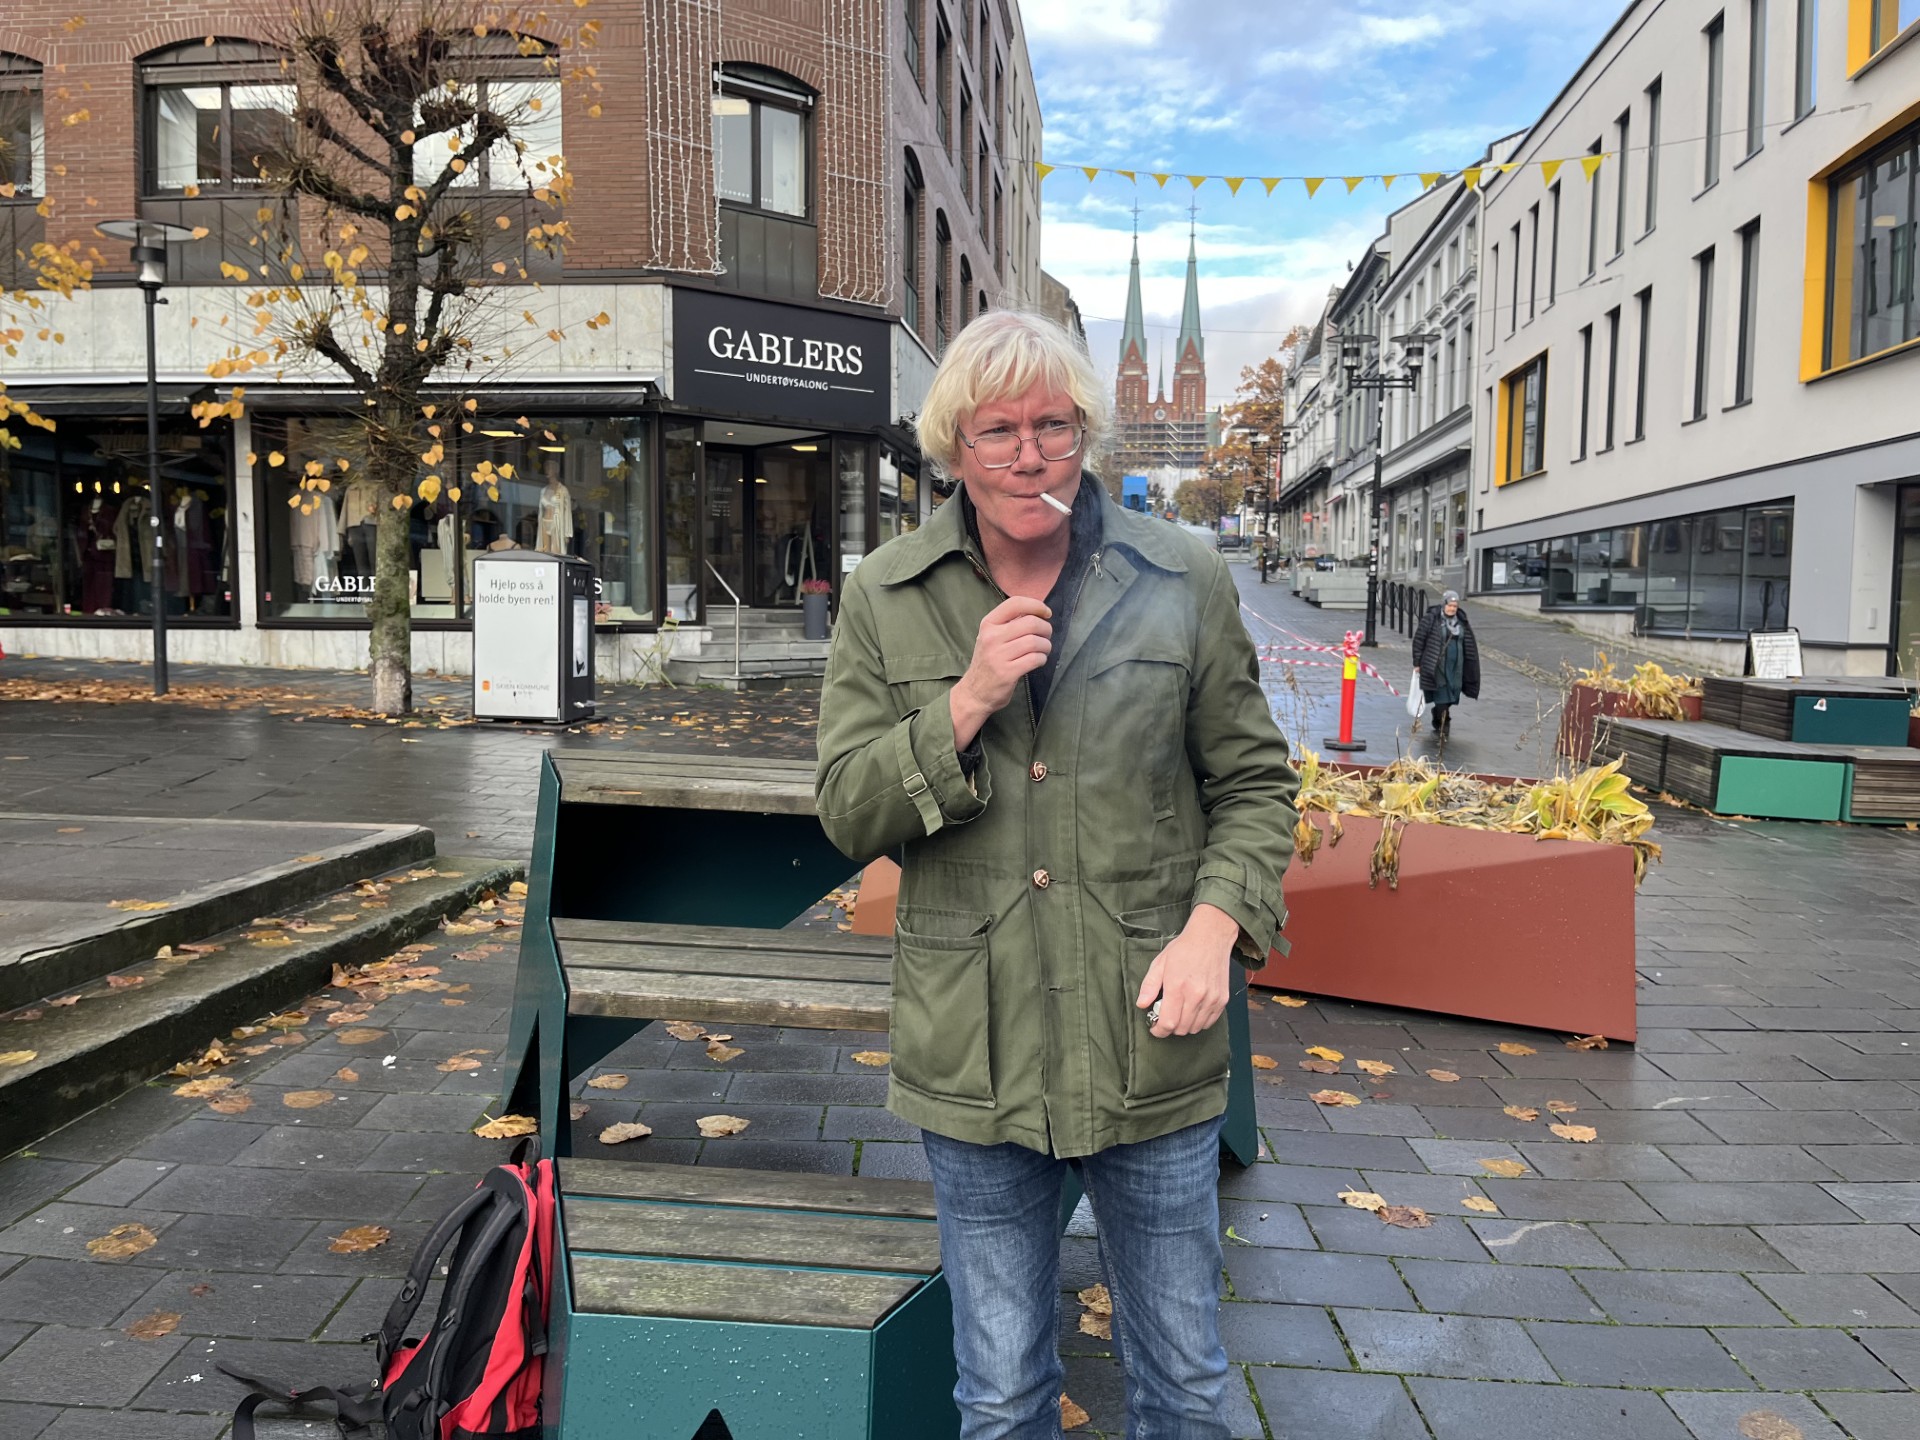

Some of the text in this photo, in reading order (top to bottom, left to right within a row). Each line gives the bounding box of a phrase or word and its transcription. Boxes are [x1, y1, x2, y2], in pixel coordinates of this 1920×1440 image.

[708, 326, 863, 375] GABLERS
[746, 372, 829, 391] UNDERTØYSALONG
[315, 575, 376, 592] GABLE
[490, 579, 544, 591] Hjelp oss å
[479, 593, 554, 606] holde byen ren!
